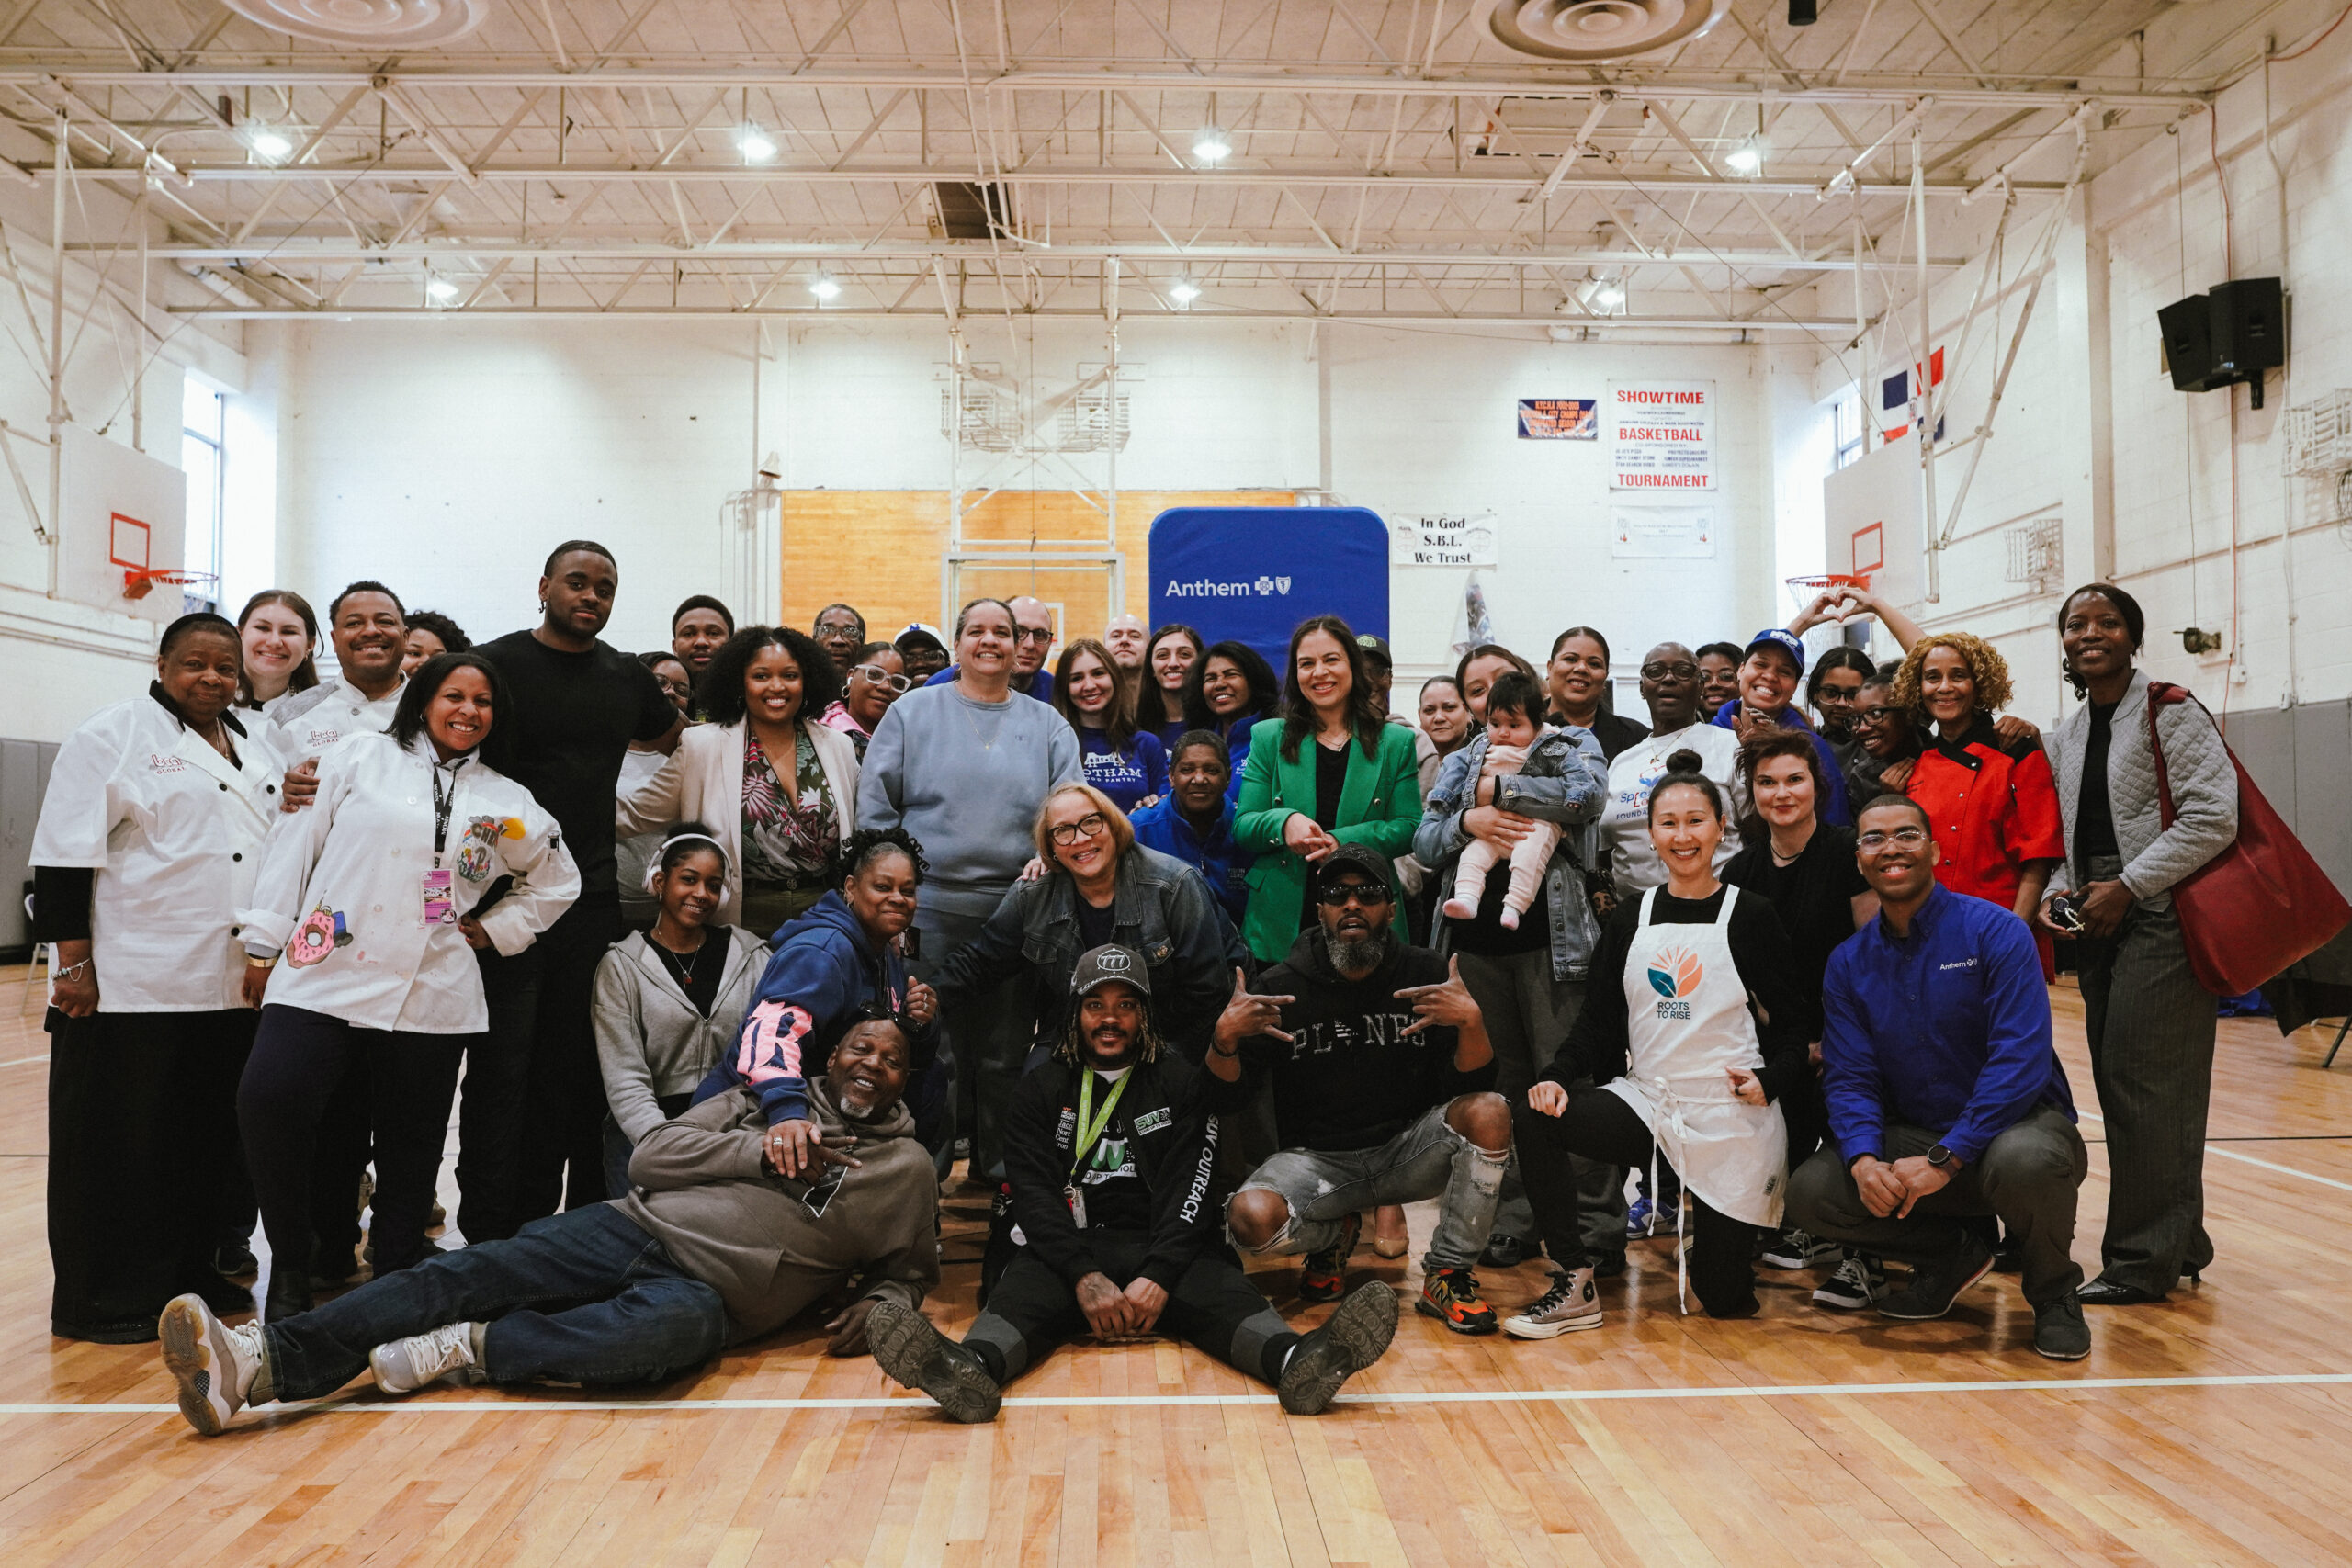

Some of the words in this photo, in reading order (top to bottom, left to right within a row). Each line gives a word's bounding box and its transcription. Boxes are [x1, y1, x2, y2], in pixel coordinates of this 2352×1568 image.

[1617, 389, 1704, 404] SHOWTIME
[1619, 428, 1703, 441] BASKETBALL
[1618, 474, 1709, 487] TOURNAMENT
[1420, 518, 1433, 528] In
[1439, 518, 1465, 529] God
[1424, 535, 1462, 547] S.B.L.
[1415, 552, 1433, 563] We
[1438, 552, 1472, 563] Trust
[1165, 578, 1250, 597] Anthem
[1082, 767, 1143, 778] OTHAM
[1616, 809, 1647, 820] FOUNDA
[1100, 954, 1126, 969] 777
[1939, 961, 1966, 971] Anthem
[1657, 1001, 1690, 1010] ROOTS
[1657, 1010, 1668, 1020] TO
[1670, 1010, 1691, 1020] RISE
[1058, 1120, 1073, 1129] Jaco
[1135, 1111, 1161, 1129] SUV
[1057, 1128, 1071, 1137] Nort
[1205, 1113, 1219, 1149] SUV
[1055, 1134, 1069, 1144] Cent
[1179, 1147, 1214, 1224] OUTREACH
